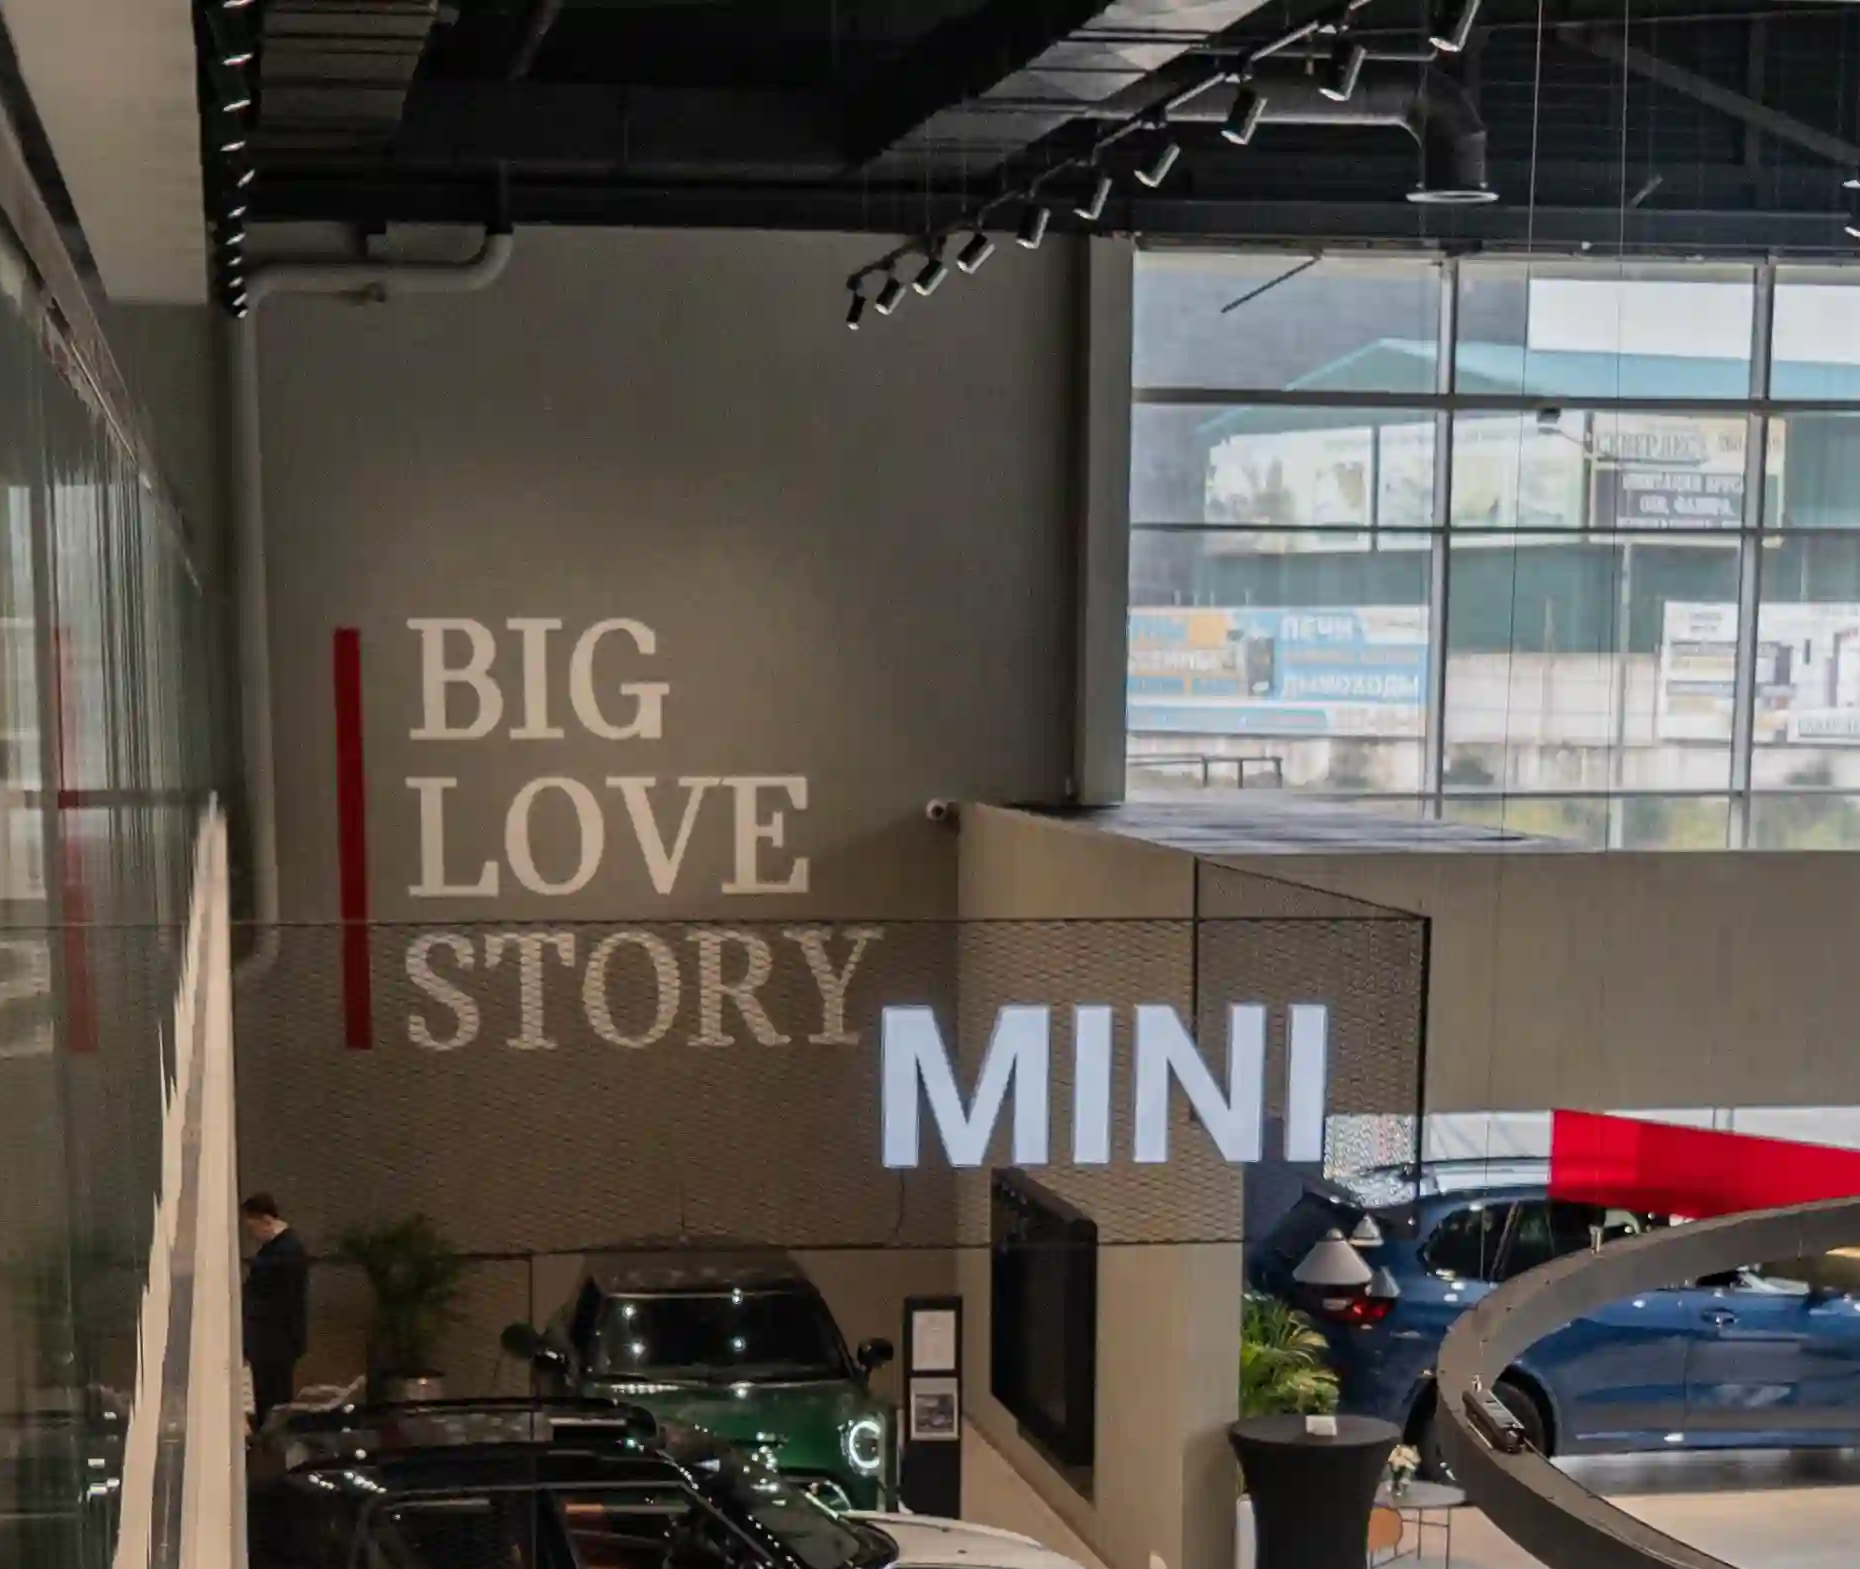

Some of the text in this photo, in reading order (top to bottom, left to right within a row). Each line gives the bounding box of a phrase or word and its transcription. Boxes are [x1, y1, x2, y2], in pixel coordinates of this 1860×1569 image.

[407, 617, 670, 741] BIG
[405, 775, 809, 897] LOVE
[403, 928, 883, 1051] STORY
[880, 1003, 1328, 1169] MINI
